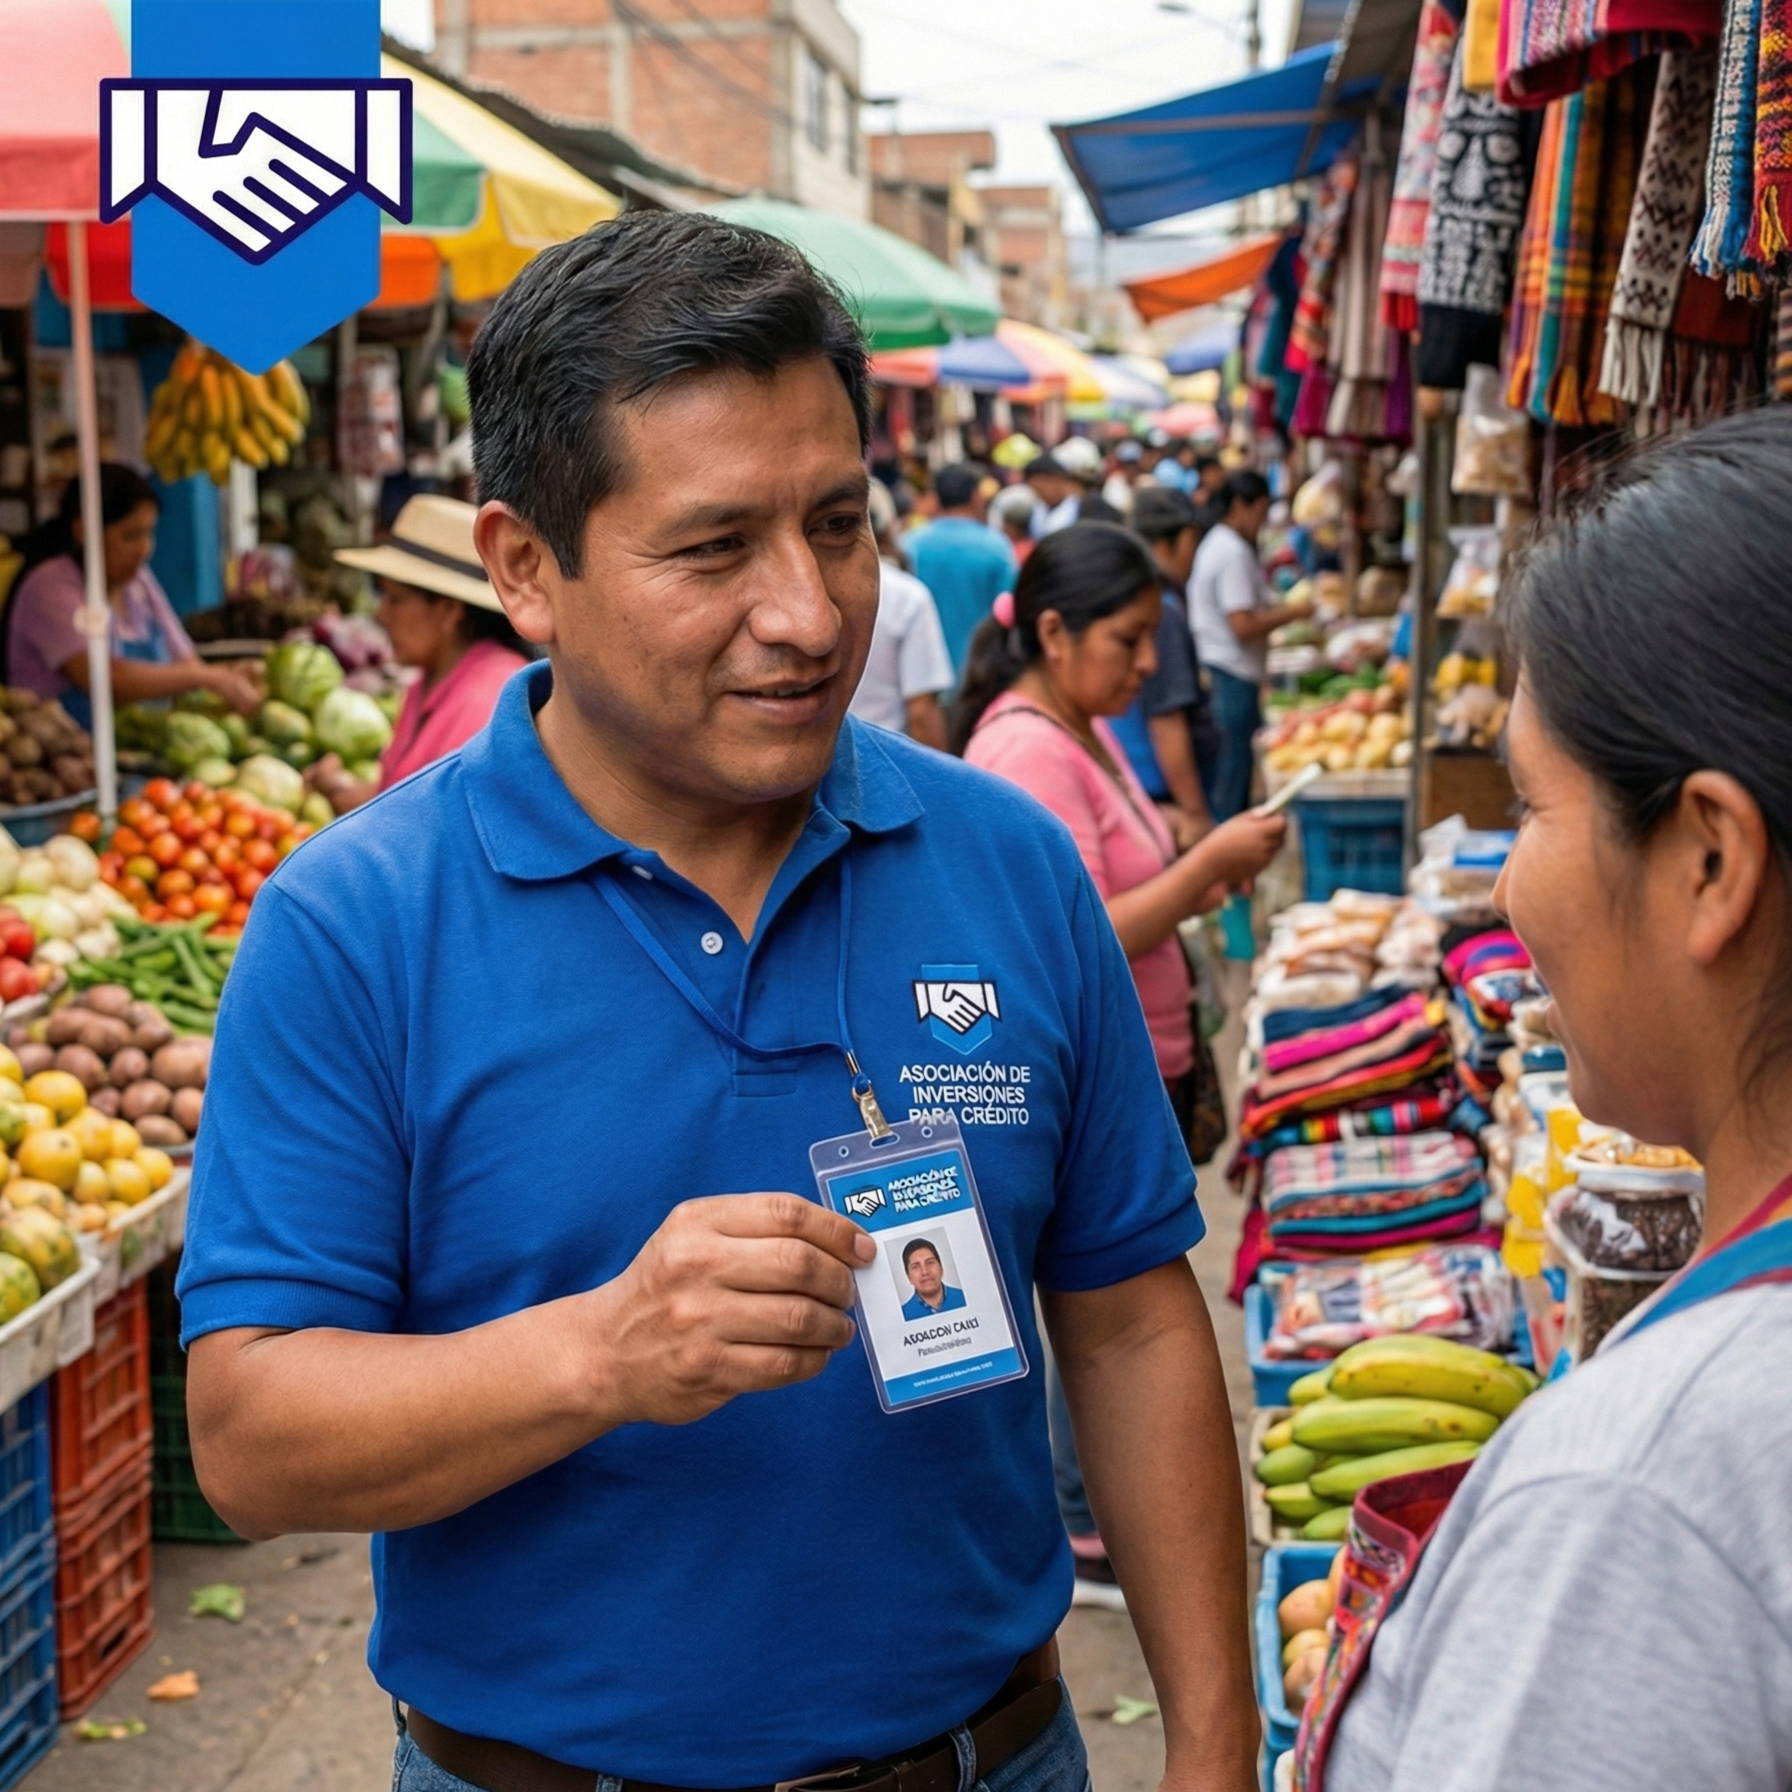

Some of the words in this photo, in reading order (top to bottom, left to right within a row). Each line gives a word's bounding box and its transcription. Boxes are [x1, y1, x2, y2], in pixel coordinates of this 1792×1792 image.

[899, 1060, 1006, 1083] ASOCIACIÓN
[1010, 1066, 1030, 1083] DE
[913, 1086, 1025, 1104] INVERSIONES
[909, 1107, 957, 1125] PARA
[961, 1103, 1030, 1125] CRÉDITO
